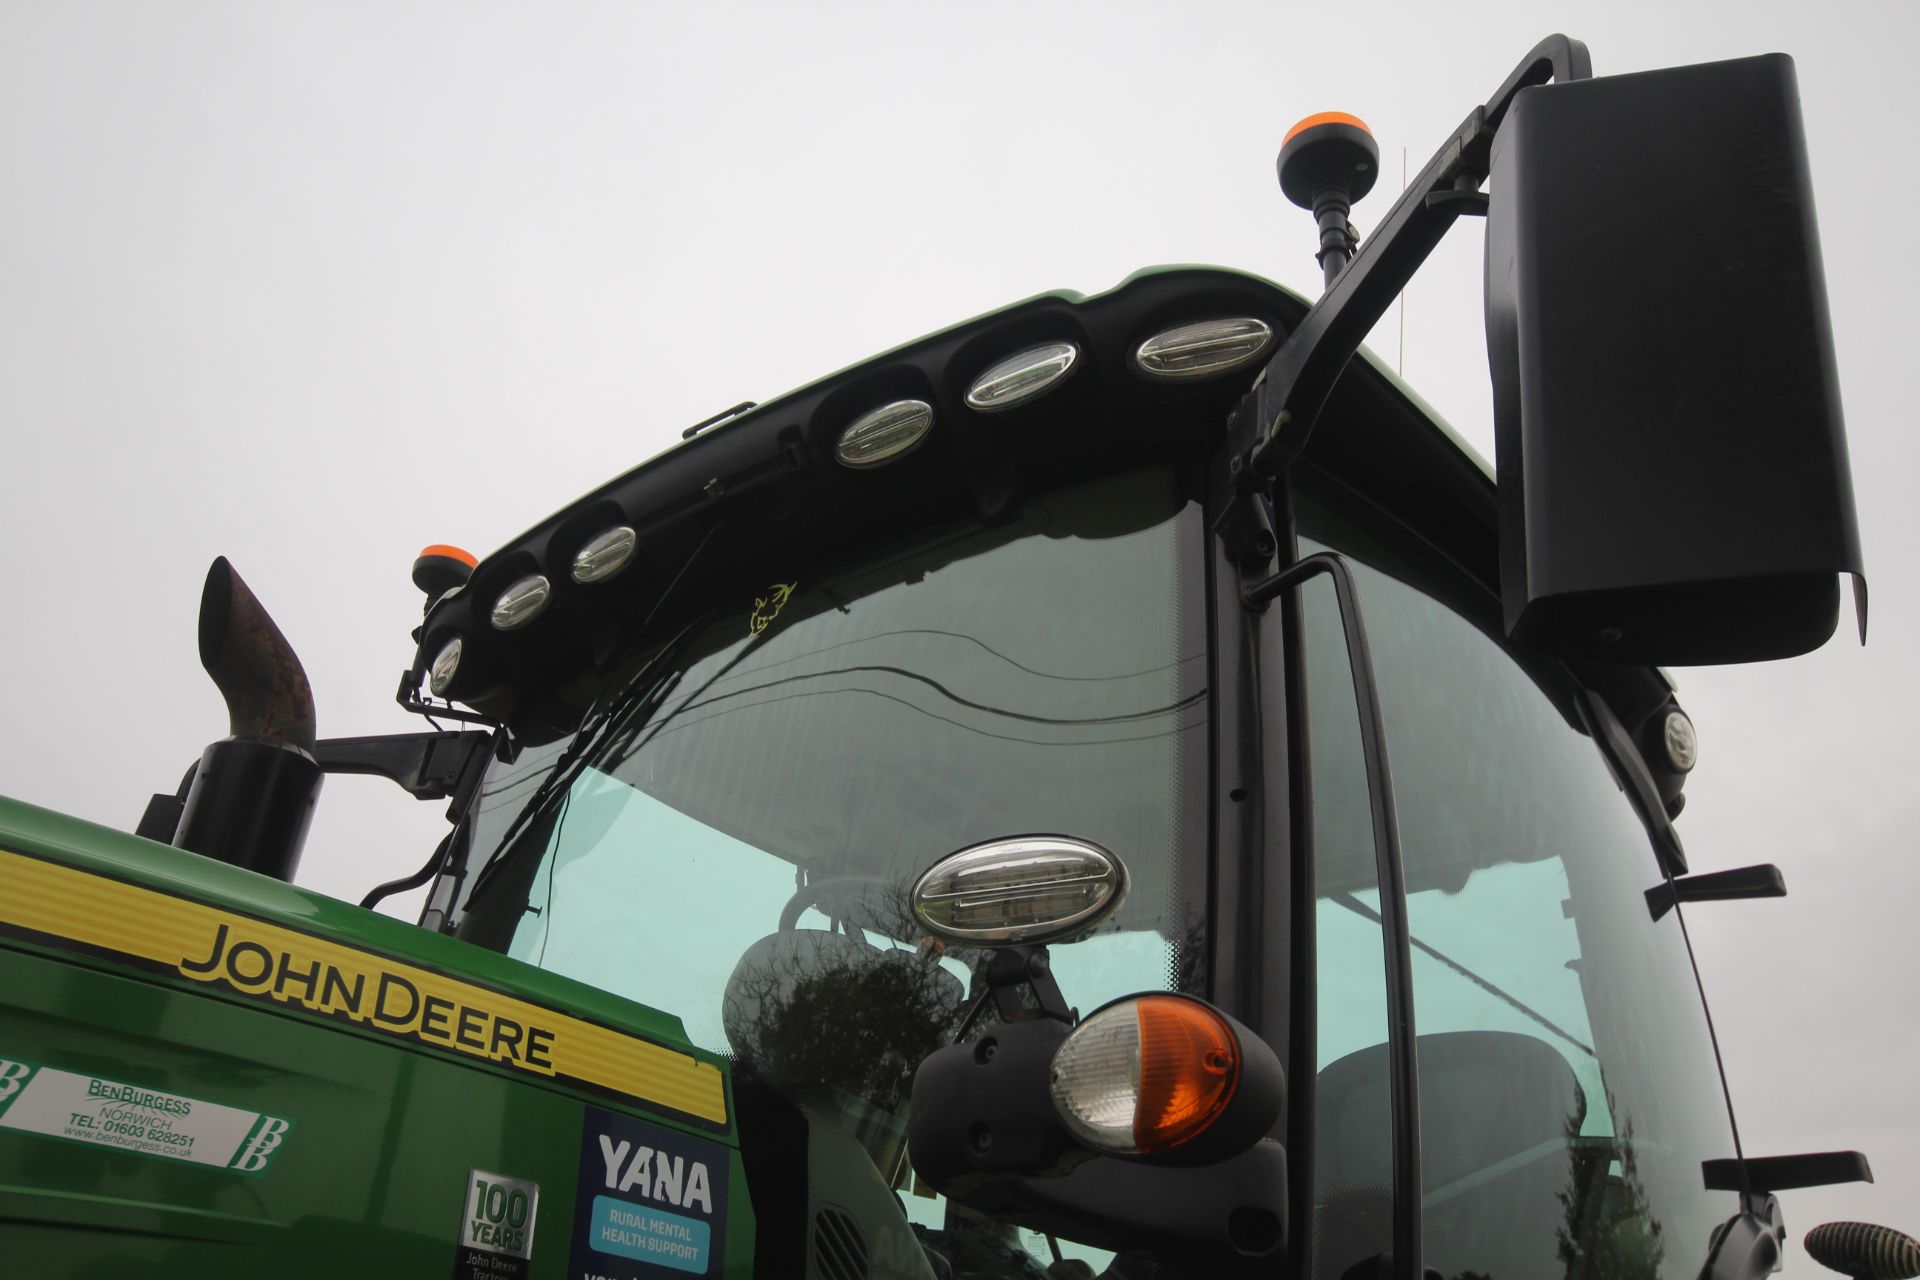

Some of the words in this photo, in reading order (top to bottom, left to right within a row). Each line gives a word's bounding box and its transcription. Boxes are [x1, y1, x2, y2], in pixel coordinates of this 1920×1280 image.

[180, 923, 366, 1015] JOHN
[373, 971, 555, 1070] DEERE
[69, 1112, 101, 1130] TEL:
[103, 1120, 146, 1138] 01603
[147, 1129, 195, 1148] 628251
[99, 1107, 173, 1131] NORWICH
[64, 1126, 192, 1158] www.benburgess.co.uk
[598, 1133, 713, 1215] YANA
[476, 1179, 529, 1229] 100
[470, 1220, 524, 1252] YEARS
[609, 1208, 648, 1232] RURAL
[649, 1218, 692, 1242] MENTAL
[602, 1225, 647, 1249] HEALTH
[647, 1237, 699, 1261] SUPPORT
[465, 1251, 489, 1268] John
[491, 1255, 518, 1274] Deere
